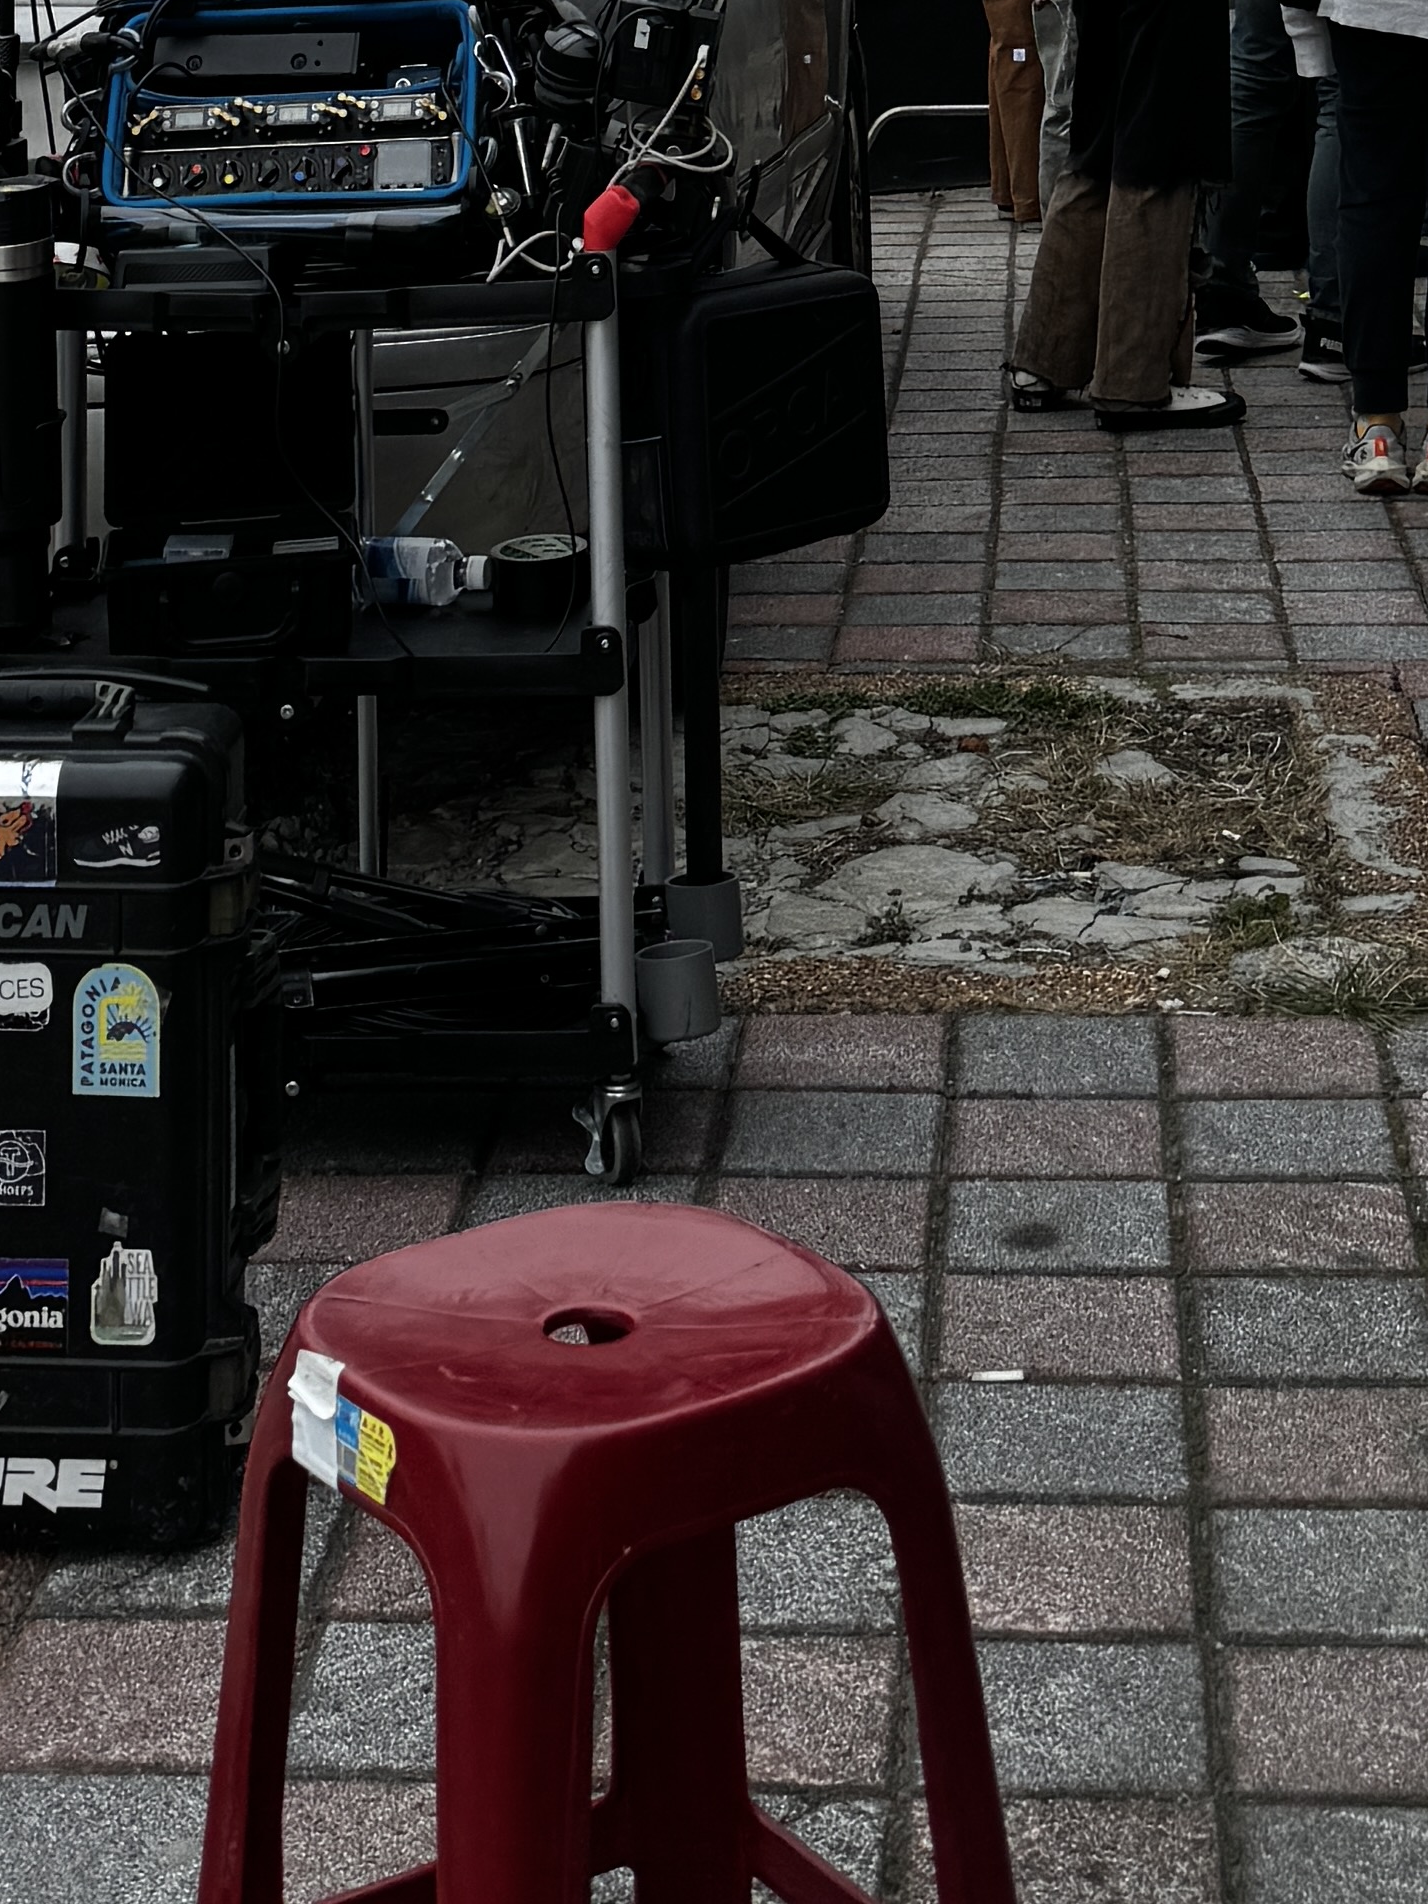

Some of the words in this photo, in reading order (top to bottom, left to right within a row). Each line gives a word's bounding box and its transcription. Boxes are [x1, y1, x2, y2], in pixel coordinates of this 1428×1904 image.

[81, 976, 121, 1086] PATAGONIA
[100, 1062, 146, 1076] SANTA
[100, 1077, 147, 1088] MONICA
